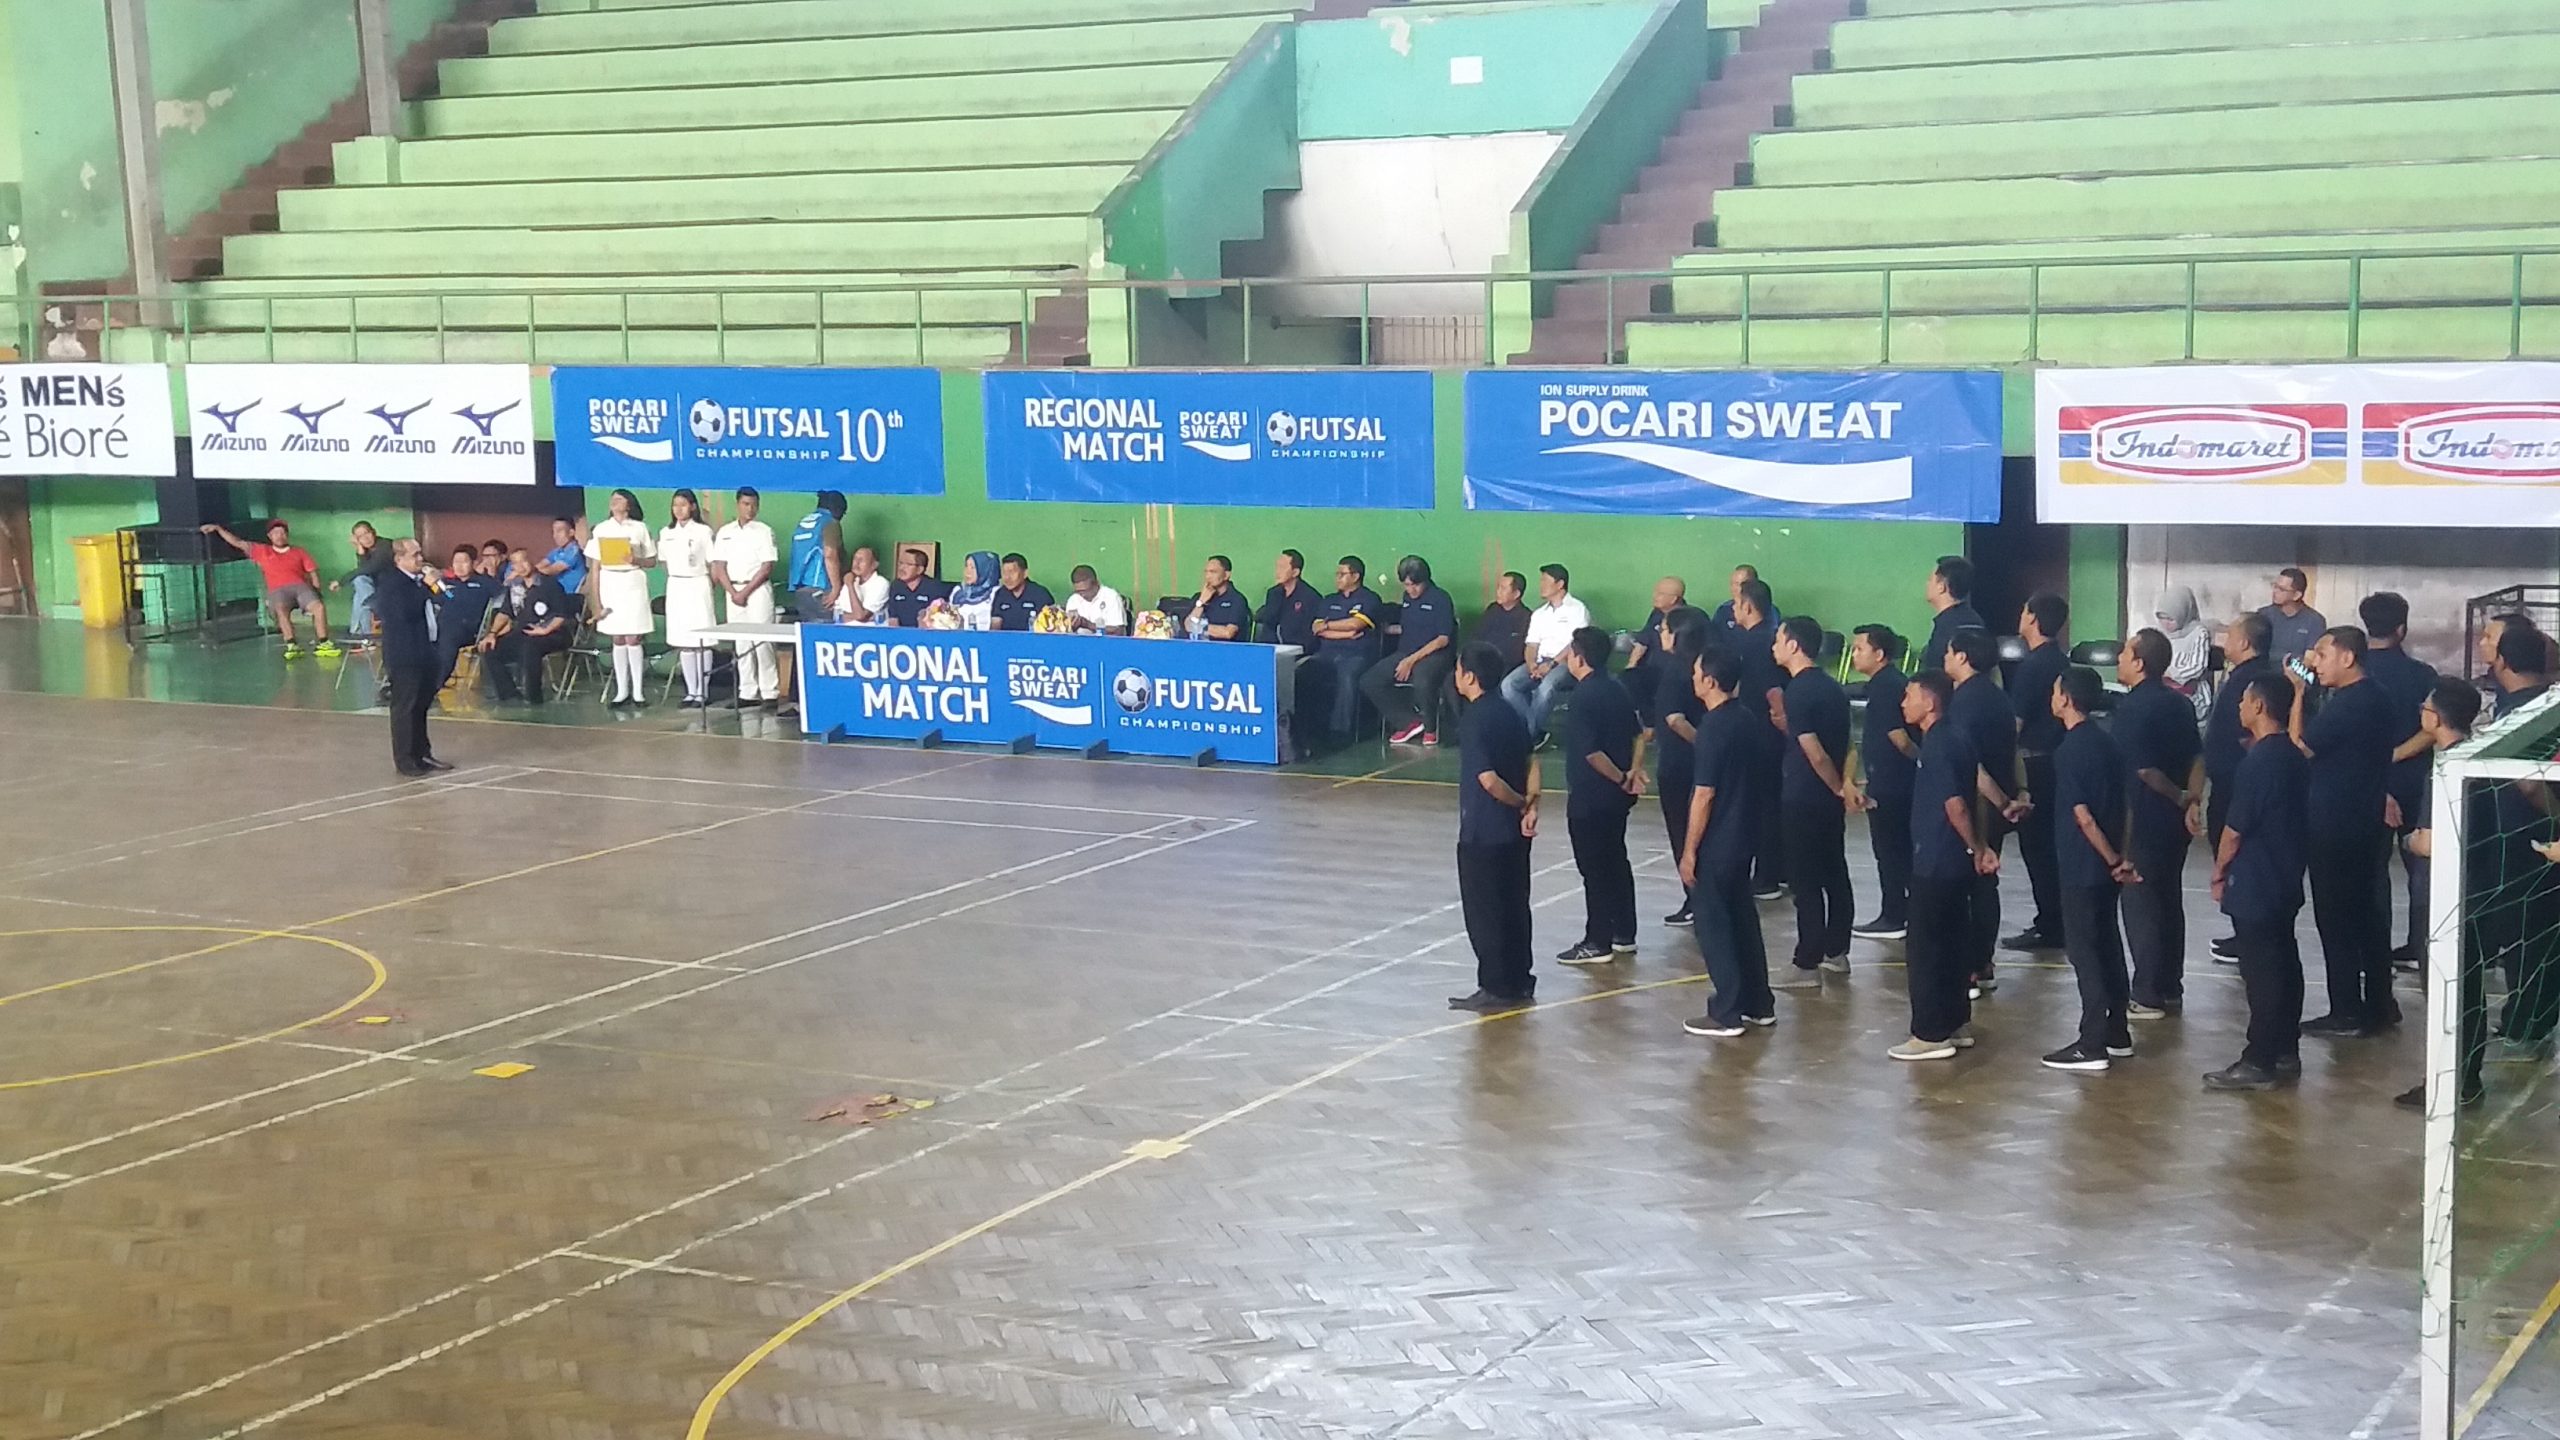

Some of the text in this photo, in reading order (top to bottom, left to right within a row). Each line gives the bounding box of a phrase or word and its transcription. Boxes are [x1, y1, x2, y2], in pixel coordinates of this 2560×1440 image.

[1540, 384, 1649, 397] ION SUPPLY DRINK
[589, 398, 668, 417] POCARI
[1024, 398, 1163, 429] REGIONAL
[1179, 411, 1248, 426] POCARI
[1540, 400, 1903, 439] POCARI SWEAT
[24, 413, 129, 459] Bioré
[590, 416, 662, 434] SWEAT
[728, 407, 904, 462] FUTSAL 10th
[1179, 425, 1242, 440] SWEAT
[1299, 417, 1387, 441] FUTSAL
[696, 448, 830, 460] CHAMPIONSHIP
[1062, 431, 1165, 462] MATCH
[2109, 430, 2293, 458] Indomaret
[815, 640, 989, 685] REGIONAL
[1008, 664, 1087, 684] POCARI
[1009, 680, 1081, 700] SWEAT
[1154, 678, 1263, 714] FUTSAL
[862, 682, 990, 724] MATCH
[1120, 717, 1262, 735] CHAMPIONSHIP
